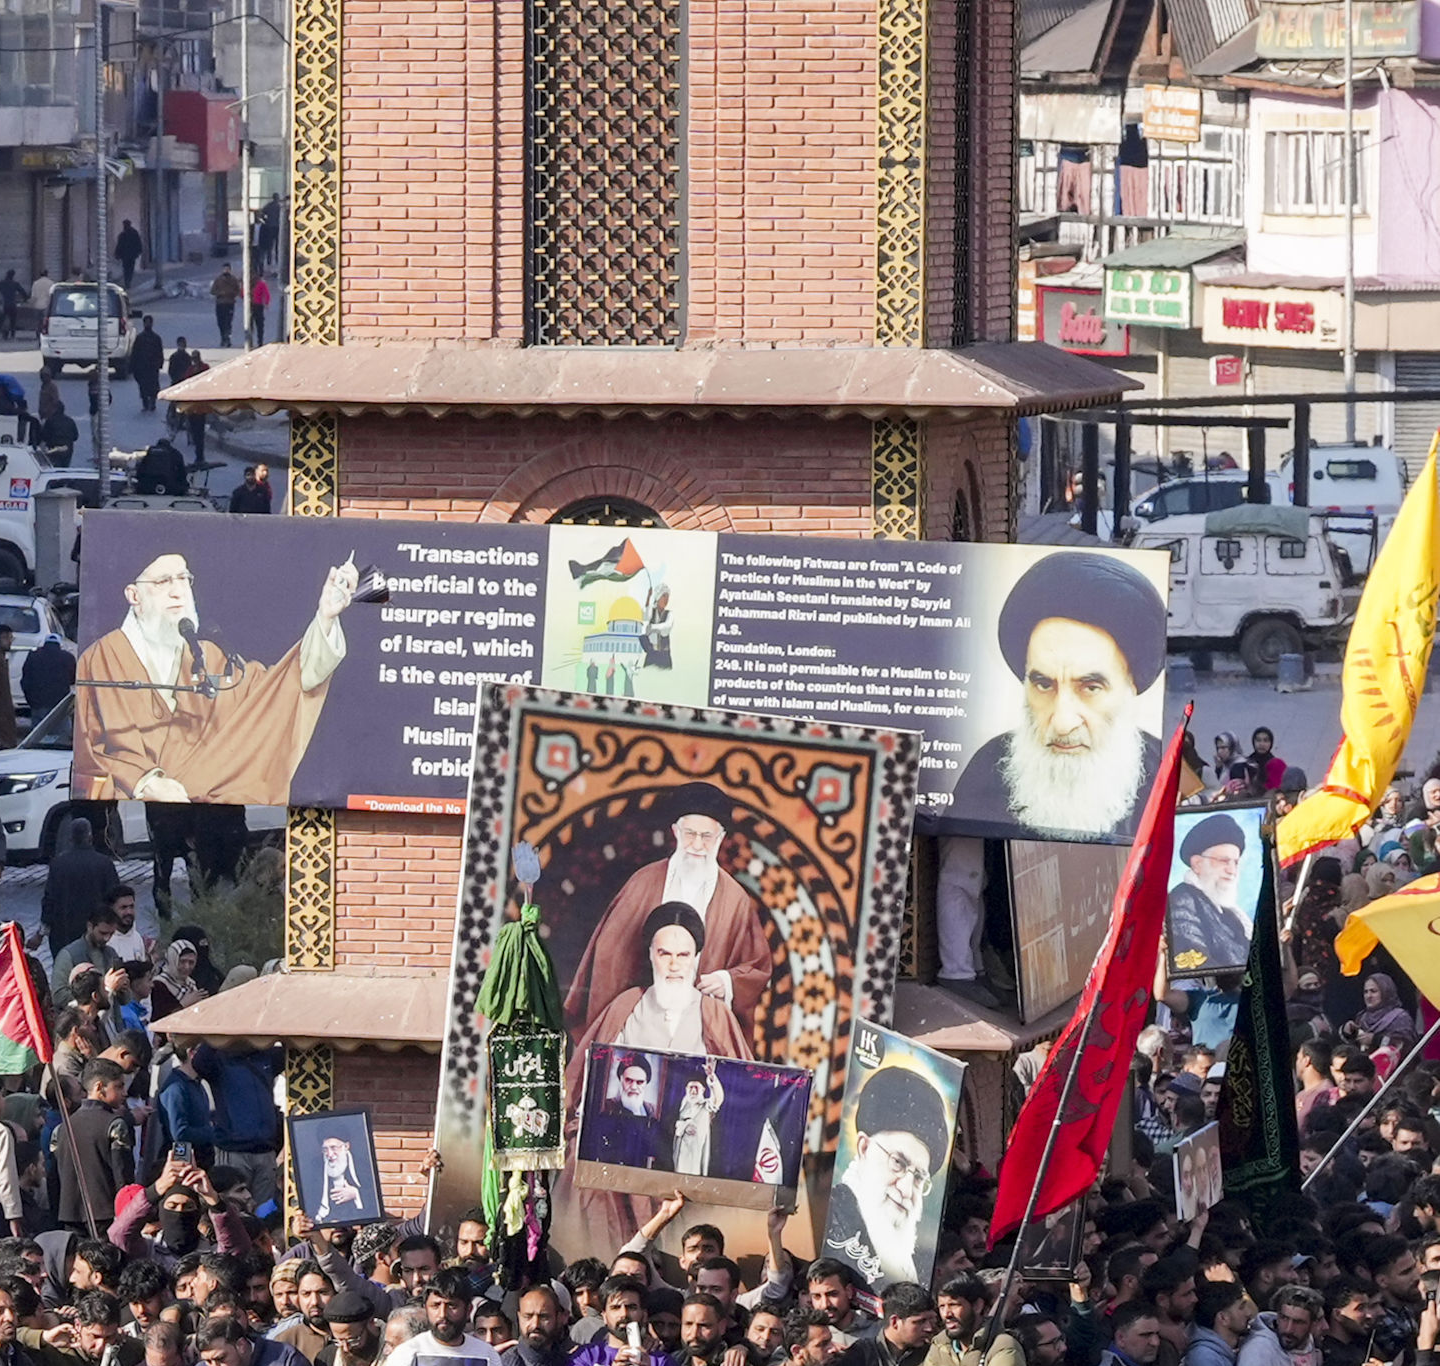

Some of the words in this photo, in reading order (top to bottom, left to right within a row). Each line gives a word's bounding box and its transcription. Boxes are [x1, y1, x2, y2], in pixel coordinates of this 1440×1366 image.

[721, 553, 744, 565] The
[746, 554, 801, 569] following
[803, 556, 846, 570] Fatwas
[848, 560, 868, 570] are
[870, 559, 899, 572] from
[917, 562, 947, 574] Code
[949, 563, 963, 575] of
[478, 578, 499, 595] to
[503, 578, 538, 597] the
[720, 571, 771, 584] Practice
[773, 572, 790, 585] for
[792, 573, 840, 587] Muslims
[842, 575, 856, 587] in
[857, 576, 876, 588] the
[916, 579, 931, 593] by
[719, 588, 775, 603] Ayatullah
[776, 590, 829, 604] Seestani
[830, 593, 892, 607] translated
[894, 595, 909, 609] by
[911, 596, 951, 611] Sayyid
[381, 607, 461, 627] usurper
[464, 608, 536, 629] regime
[718, 606, 786, 620] Muhammad
[788, 608, 817, 621] Rizvi
[819, 609, 841, 622] and
[842, 611, 901, 626] published
[903, 613, 918, 628] by
[920, 614, 953, 627] Imam
[955, 615, 971, 628] Ali
[717, 624, 742, 636] A.S.
[380, 635, 403, 653] of
[405, 635, 468, 658] Israel,
[472, 639, 534, 658] which
[716, 641, 785, 657] Foundation,
[787, 643, 836, 657] London:
[379, 664, 398, 683] is
[401, 665, 435, 684] the
[439, 671, 507, 685] enemy
[510, 670, 533, 685] of
[744, 661, 753, 673] It
[754, 661, 766, 673] is
[768, 662, 788, 674] not
[789, 662, 859, 678] permissible
[861, 665, 880, 678] for
[881, 669, 889, 679] a
[890, 667, 932, 680] Muslim
[934, 669, 947, 681] to
[949, 670, 971, 684] buy
[714, 677, 769, 692] products
[770, 678, 784, 691] of
[785, 680, 805, 693] the
[806, 681, 864, 696] countries
[865, 683, 890, 697] that
[892, 687, 912, 698] are
[914, 686, 926, 698] in
[927, 690, 935, 699] a
[936, 688, 969, 700] state
[713, 694, 727, 706] of
[728, 696, 752, 707] war
[753, 696, 781, 709] with
[782, 697, 814, 711] Islam
[815, 699, 838, 712] and
[839, 700, 891, 715] Muslims,
[893, 702, 912, 715] for
[933, 740, 962, 752] from
[945, 758, 959, 769] to
[425, 800, 443, 813] the
[445, 801, 461, 814] No
